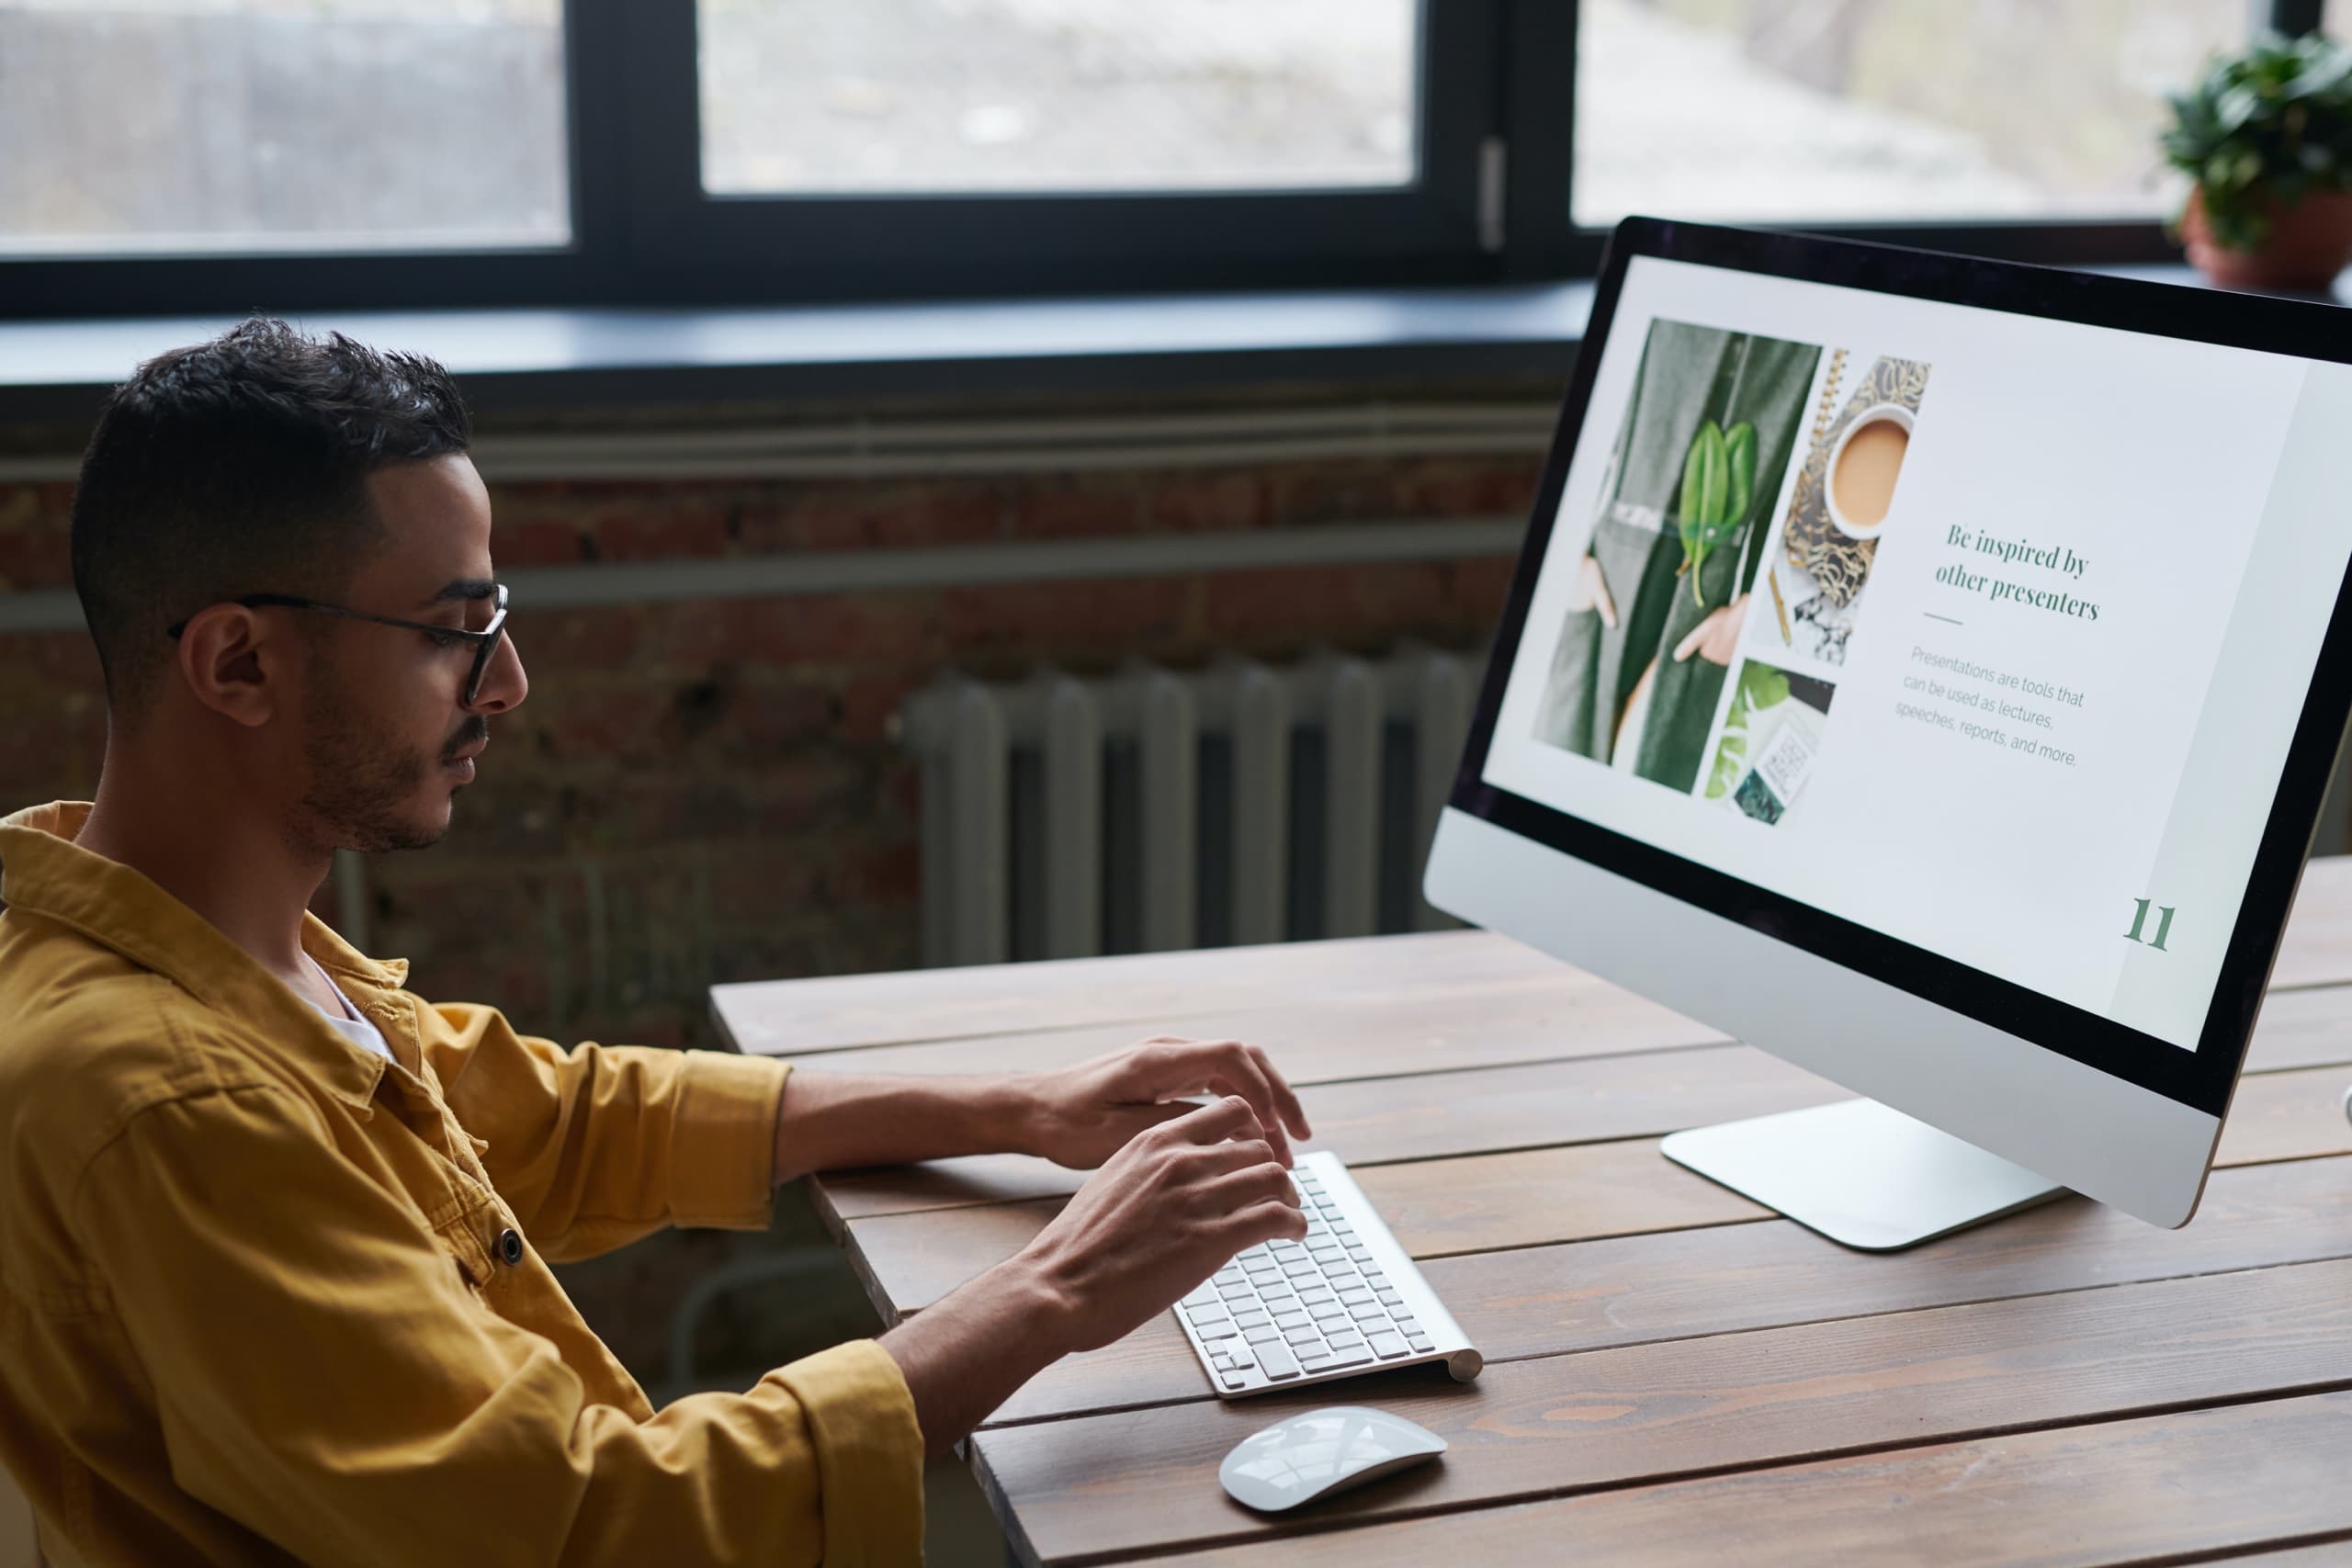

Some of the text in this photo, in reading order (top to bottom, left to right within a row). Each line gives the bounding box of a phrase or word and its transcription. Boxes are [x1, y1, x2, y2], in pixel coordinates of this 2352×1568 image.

[1947, 525, 2089, 581] Be inspired by
[1936, 564, 2100, 621] other presenters
[1904, 676, 1926, 691] can
[1928, 680, 1945, 697] be
[1947, 687, 1980, 706] used
[1980, 698, 1996, 712] as
[1911, 646, 2085, 707] Presentations are tools that
[1960, 721, 2007, 748] reports,
[2010, 736, 2038, 754] and
[2039, 745, 2076, 767] more.
[2122, 897, 2176, 952] 11
